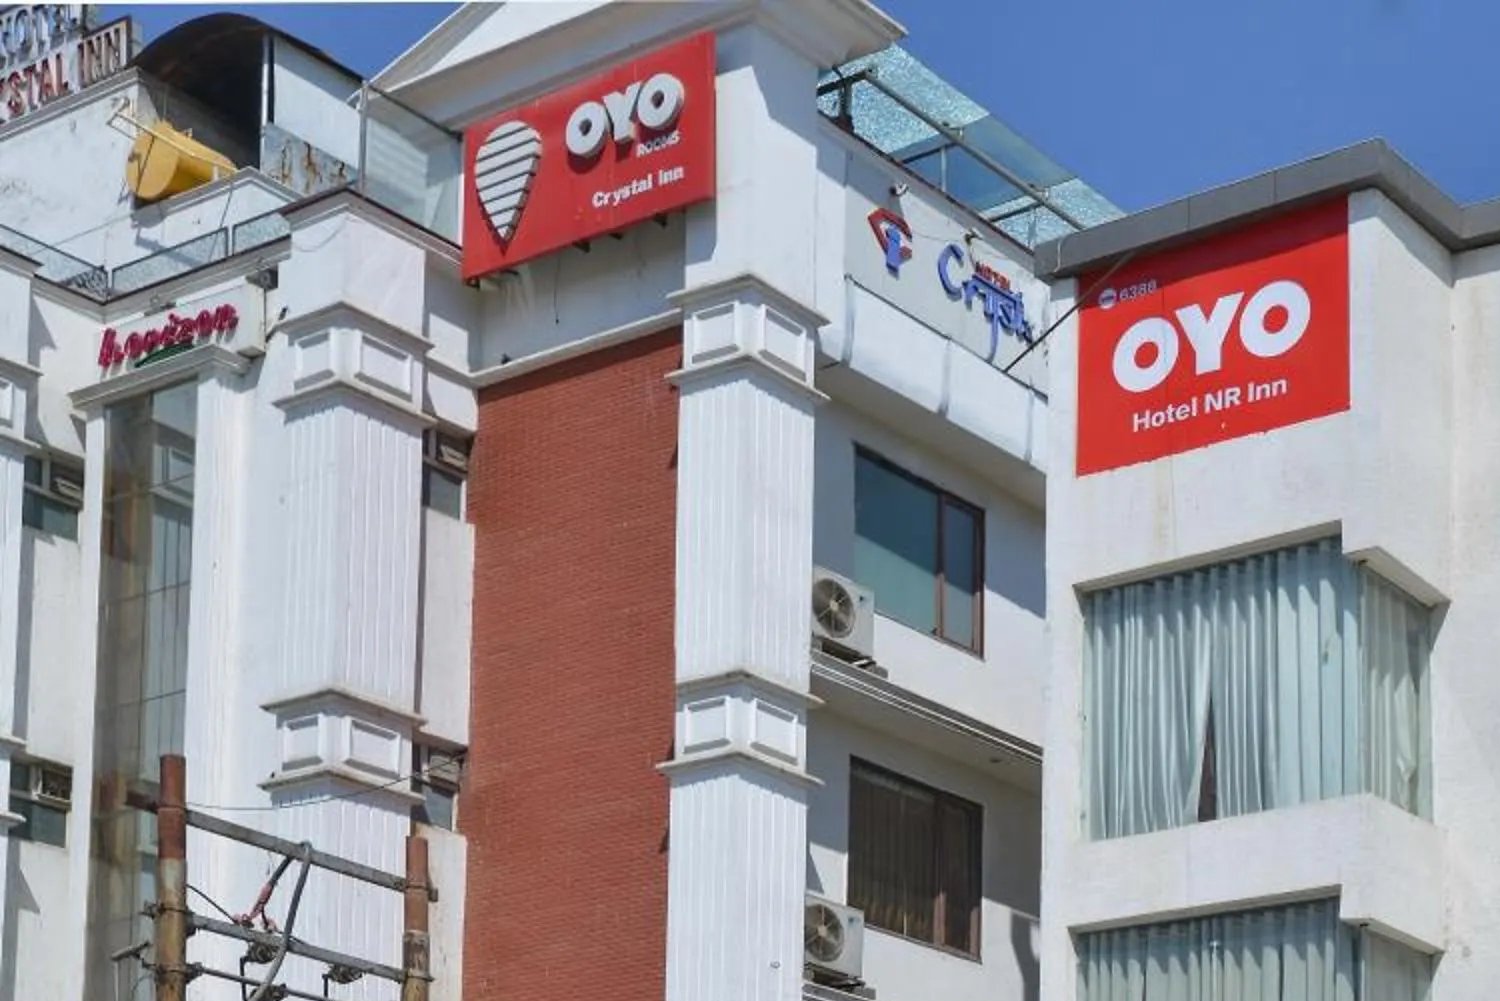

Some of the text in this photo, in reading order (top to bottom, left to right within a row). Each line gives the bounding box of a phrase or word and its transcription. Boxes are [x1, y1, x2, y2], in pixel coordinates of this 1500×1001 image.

[78, 27, 127, 89] INN
[565, 73, 685, 159] OYO
[592, 166, 684, 207] Crystal Inn
[1112, 279, 1311, 393] OYO
[1132, 377, 1288, 433] Hotel NR Inn
